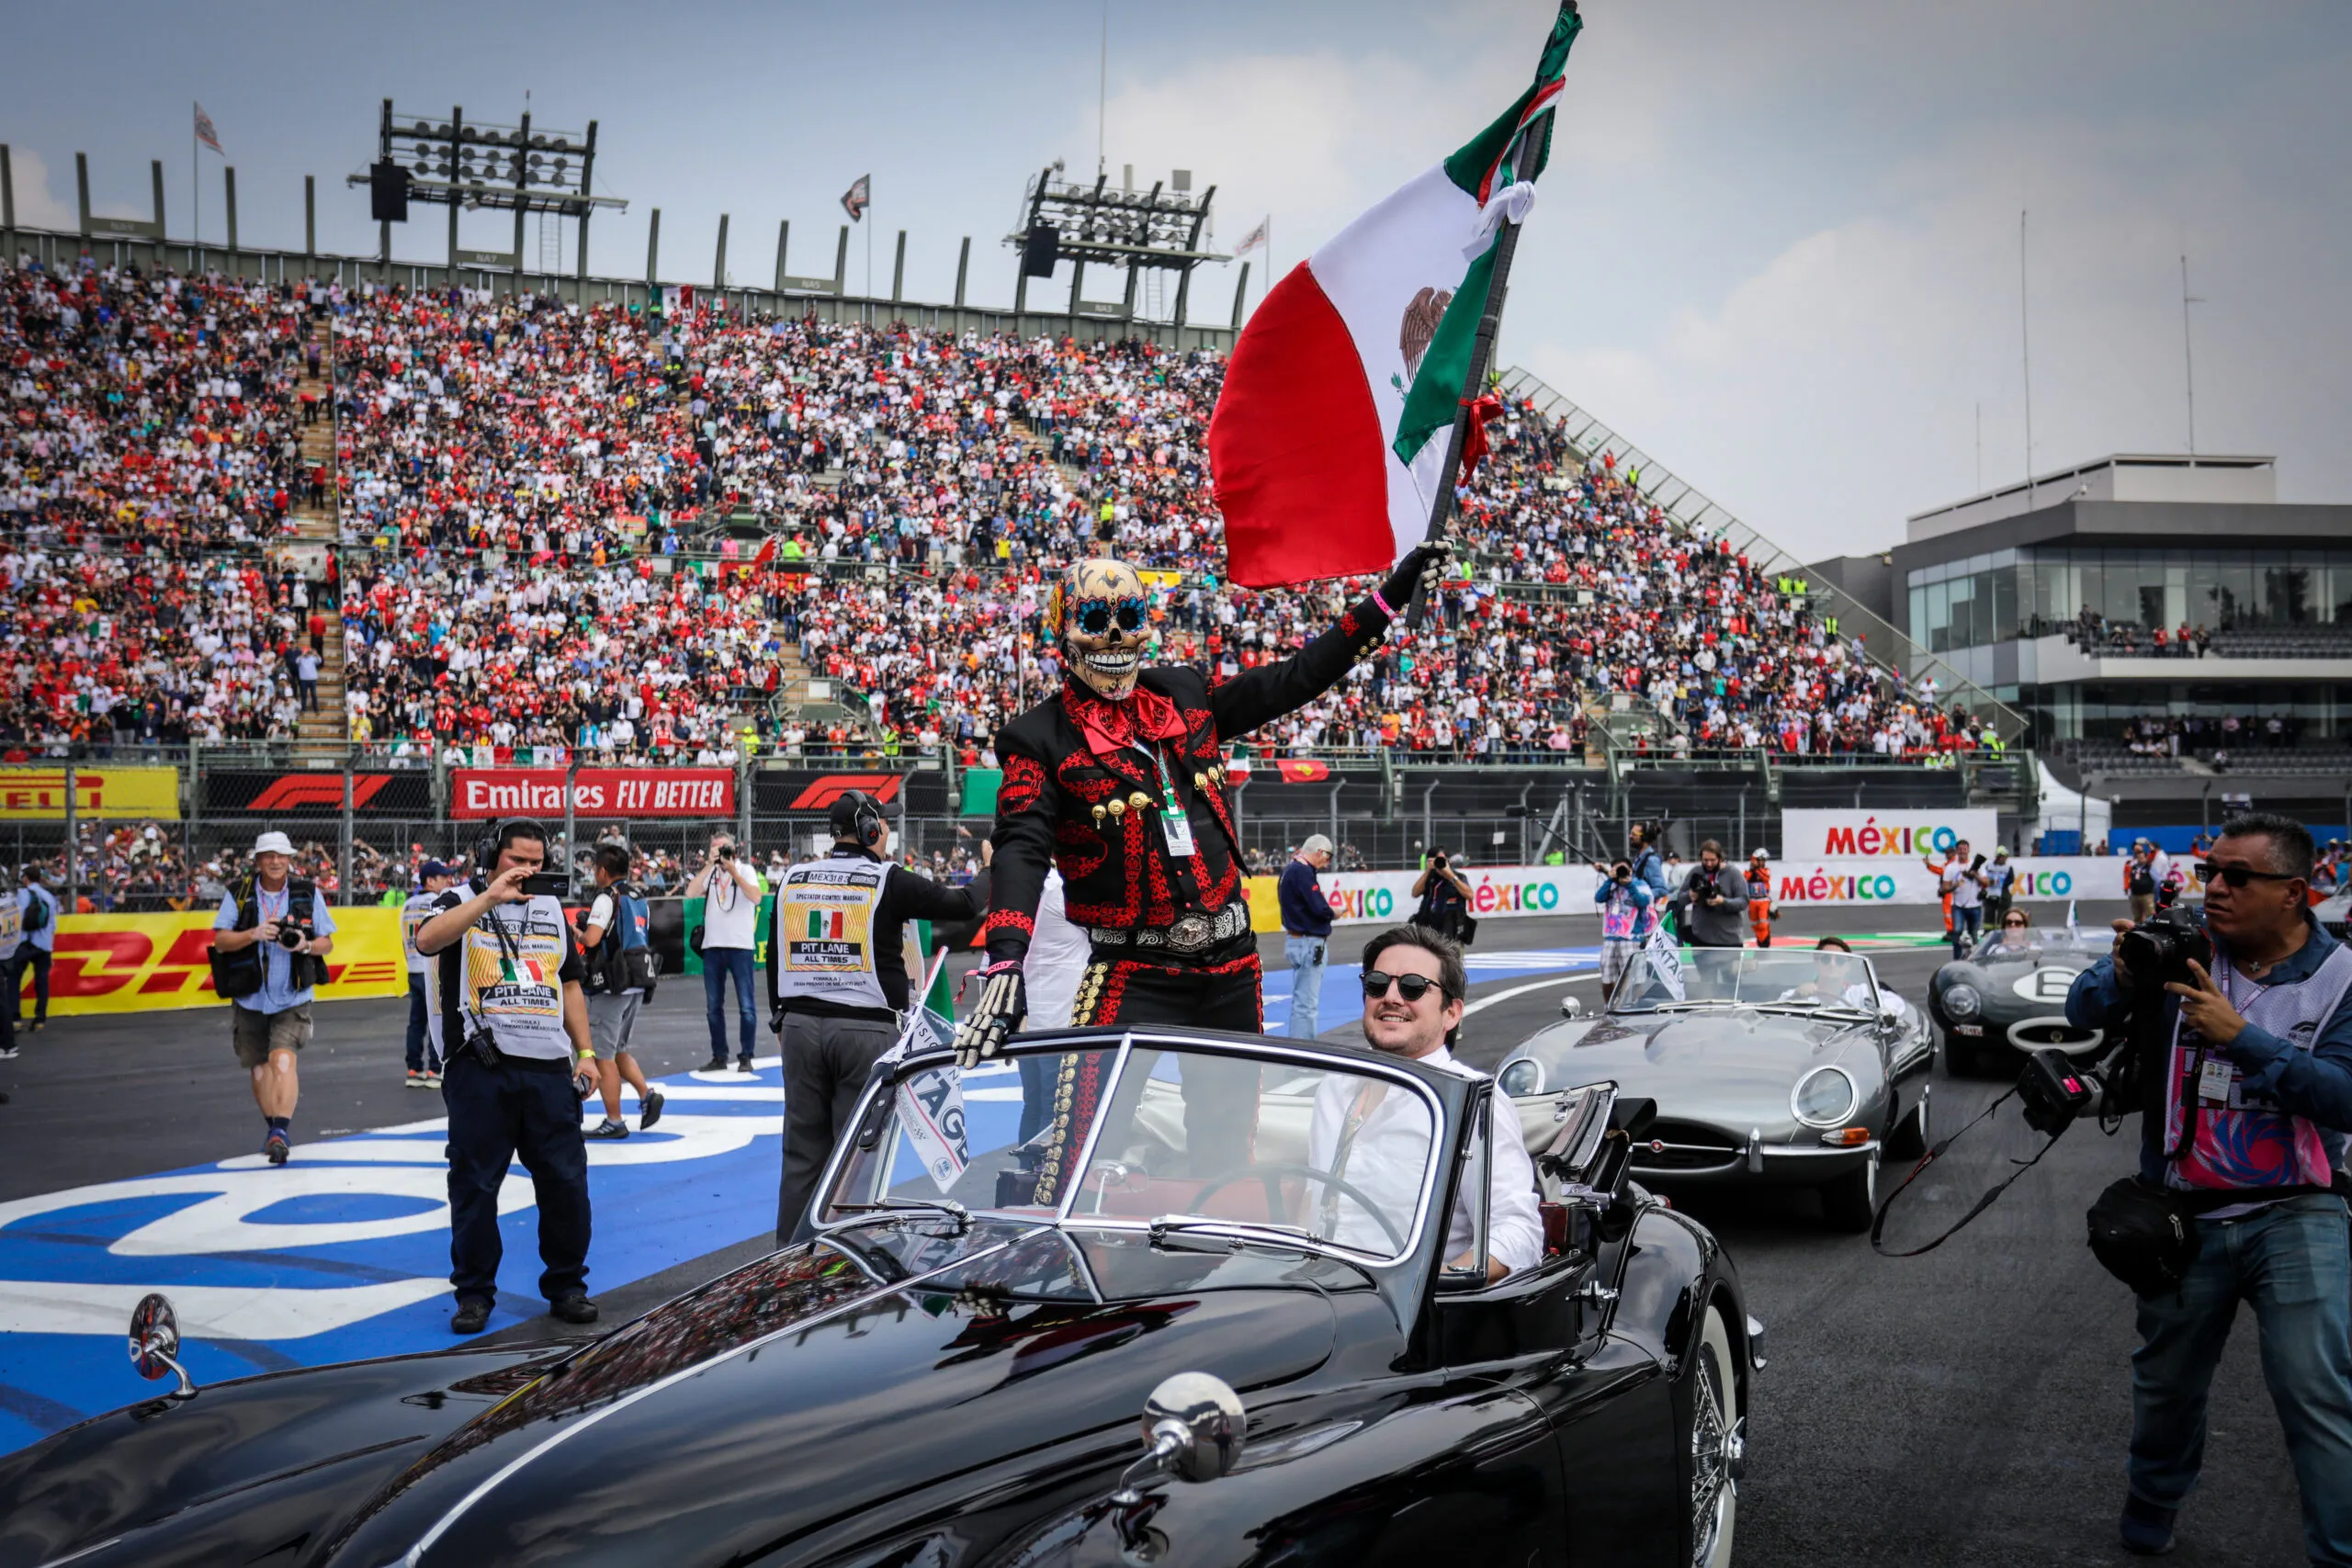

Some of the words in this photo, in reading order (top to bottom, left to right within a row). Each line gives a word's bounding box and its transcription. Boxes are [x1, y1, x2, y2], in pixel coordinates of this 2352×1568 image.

[466, 779, 605, 809] Emiraes
[616, 780, 648, 808] FLY
[653, 780, 725, 808] BETTER
[2011, 871, 2072, 897] XICO
[801, 942, 819, 953] PIT
[820, 943, 850, 954] LANE
[822, 955, 849, 964] TIMES
[494, 986, 517, 997] PIT
[519, 987, 552, 998] LANE
[500, 998, 520, 1006] ALL
[523, 998, 550, 1007] TIMES
